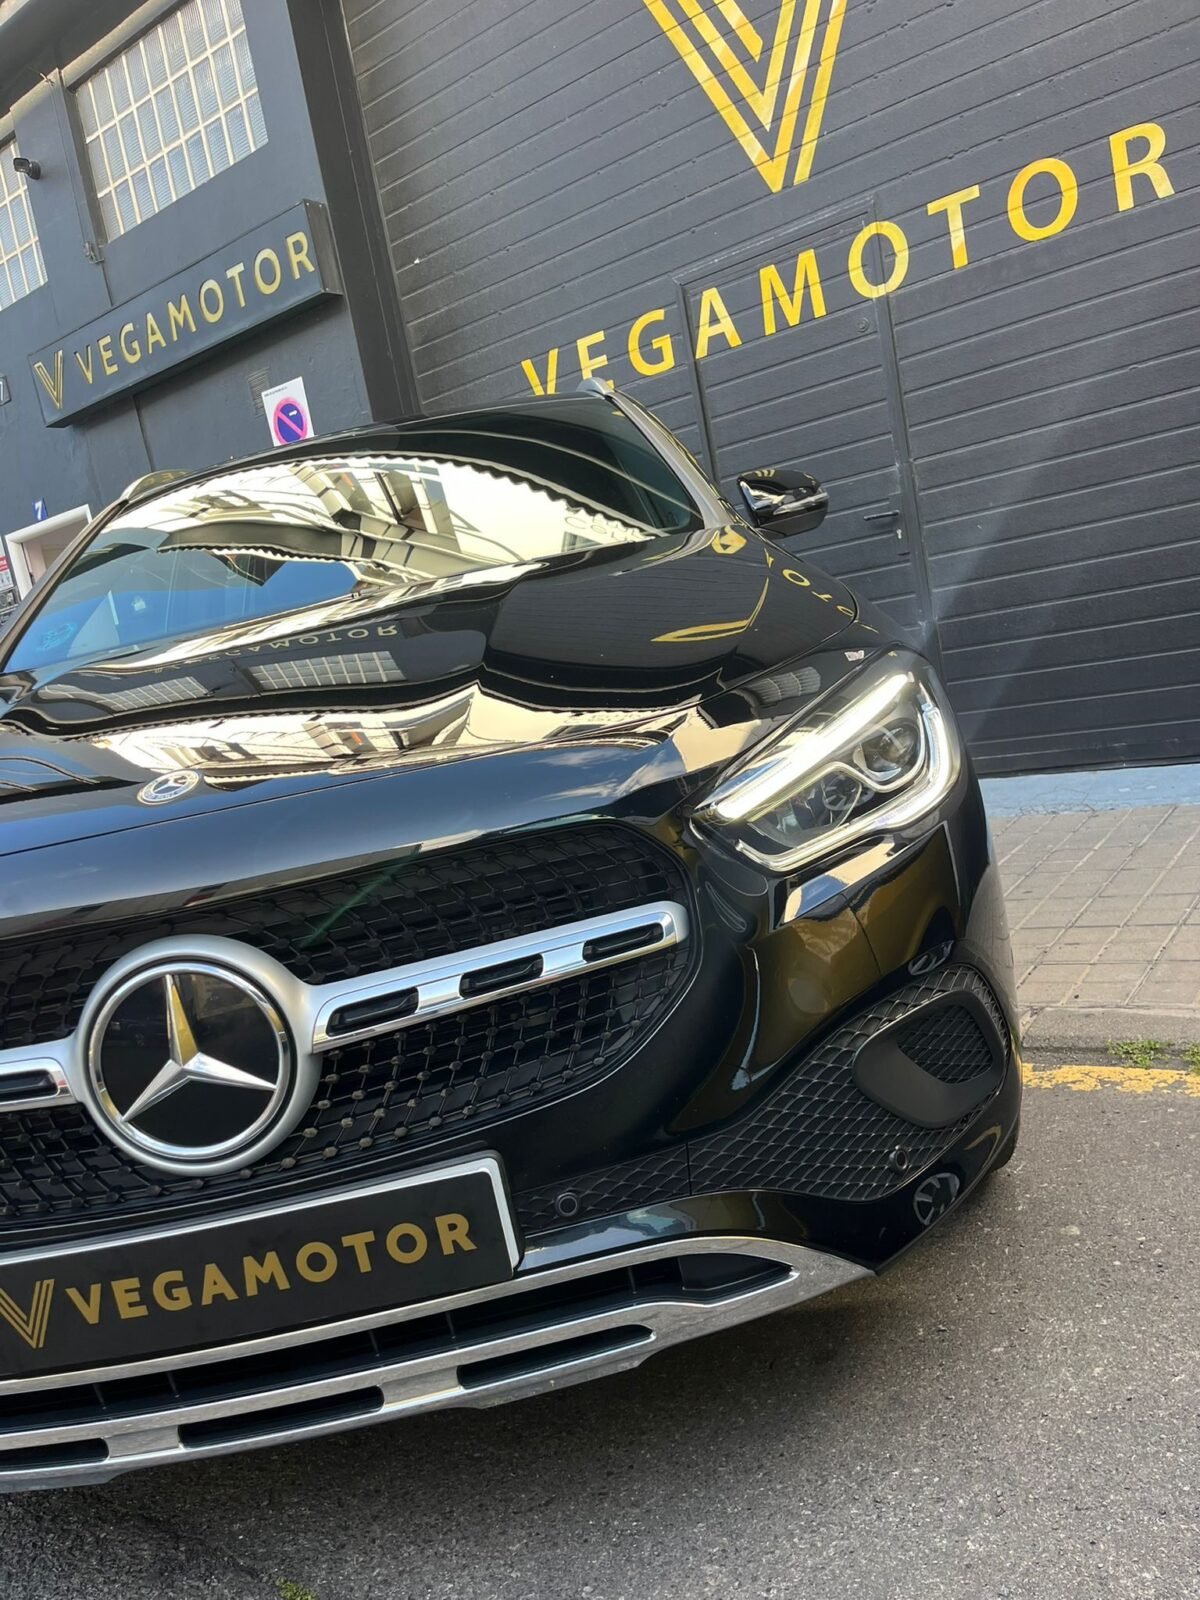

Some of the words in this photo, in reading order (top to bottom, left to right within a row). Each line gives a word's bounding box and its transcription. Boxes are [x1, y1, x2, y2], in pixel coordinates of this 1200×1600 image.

[73, 231, 315, 385] VEGAMOTOR
[520, 122, 1175, 396] VEGAMOTOR
[65, 1213, 478, 1326] VEGAMOTOR
